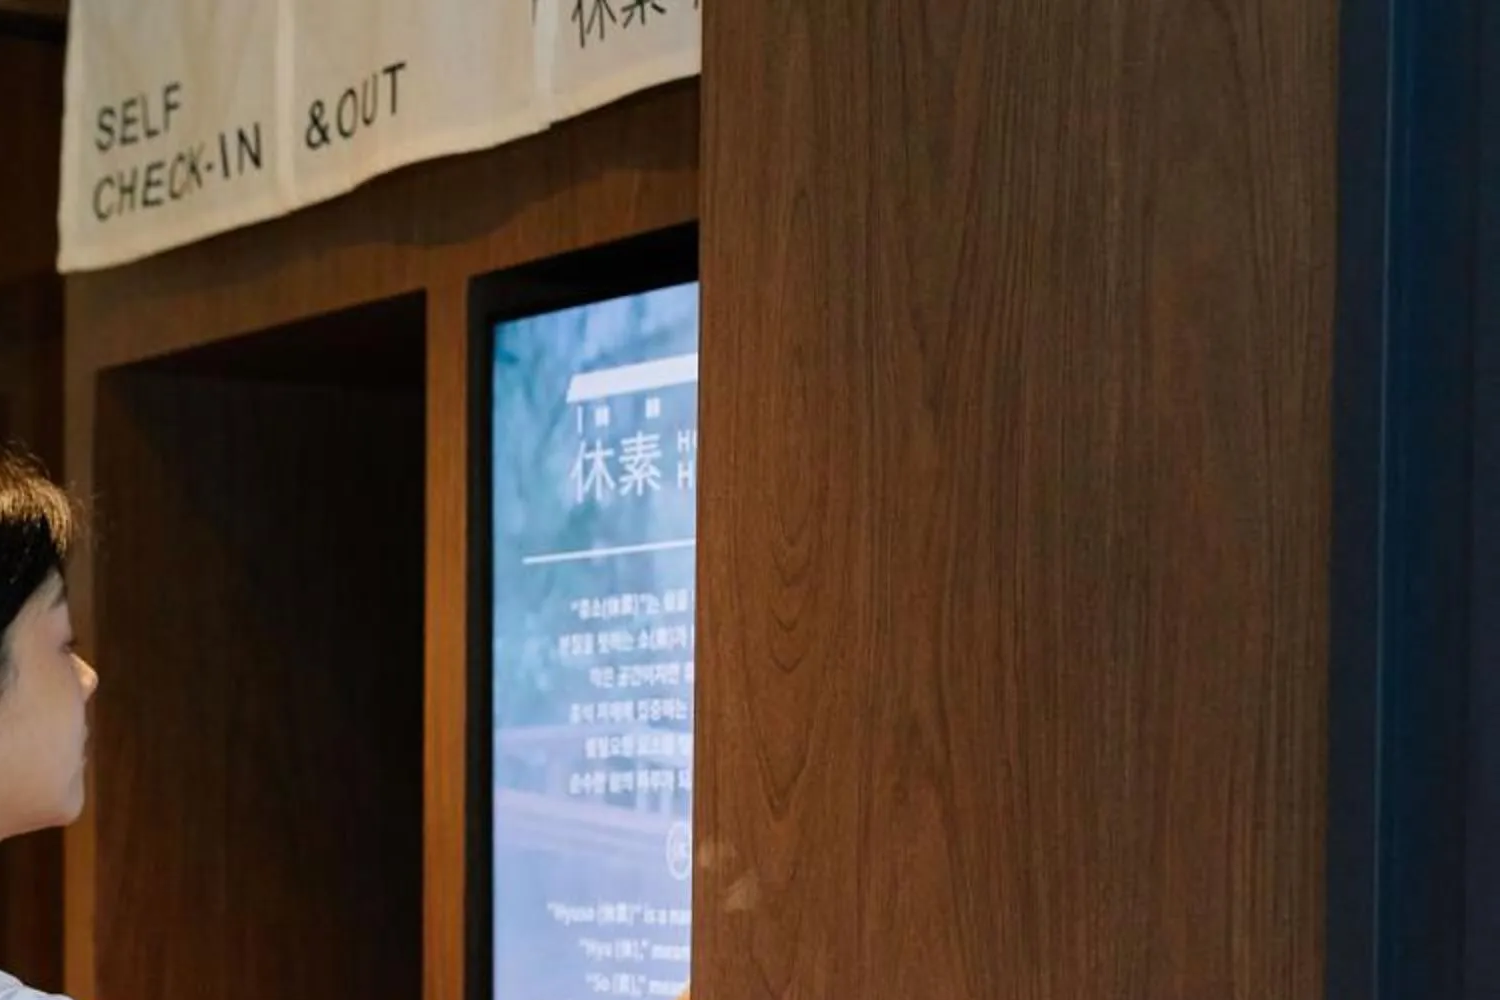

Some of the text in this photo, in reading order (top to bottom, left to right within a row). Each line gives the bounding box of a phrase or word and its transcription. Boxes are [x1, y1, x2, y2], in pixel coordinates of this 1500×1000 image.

[92, 62, 407, 223] CHECK-IN &OUT
[95, 82, 182, 152] SELF
[569, 430, 662, 504] 休素
